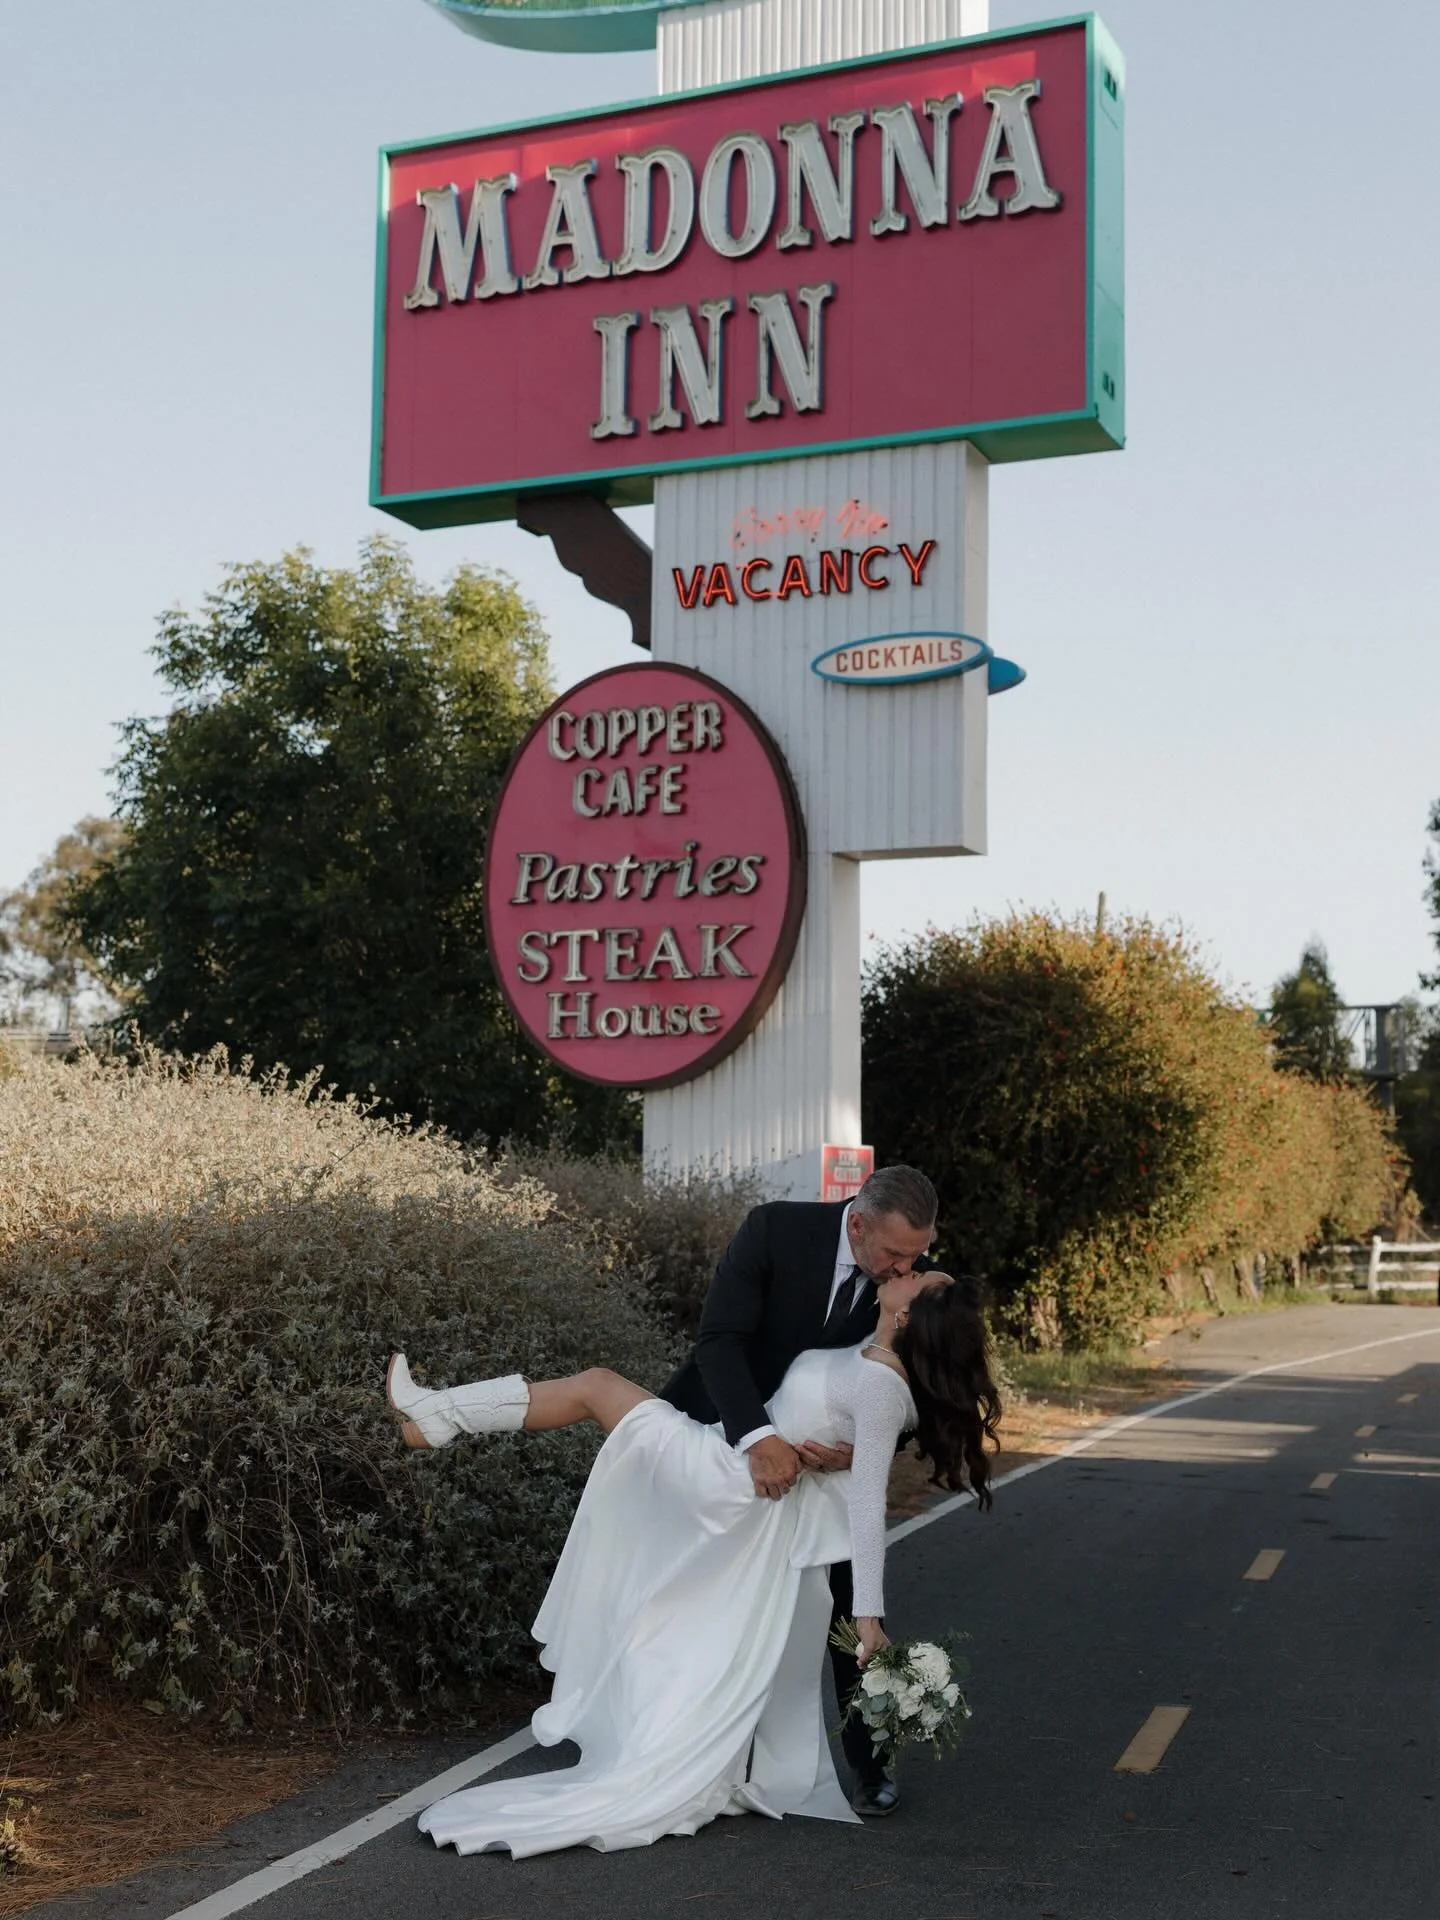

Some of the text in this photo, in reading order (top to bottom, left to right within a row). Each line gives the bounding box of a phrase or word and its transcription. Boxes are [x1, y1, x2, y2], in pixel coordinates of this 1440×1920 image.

[403, 79, 1062, 312] MADONNA
[590, 282, 834, 440] INN
[672, 539, 936, 609] VACANCY
[835, 639, 963, 673] COCKTAILS
[547, 700, 724, 761] COPPER
[572, 763, 685, 818] CAFE
[511, 840, 765, 905] Pastries
[516, 924, 754, 983] STEAK
[545, 991, 722, 1039] House
